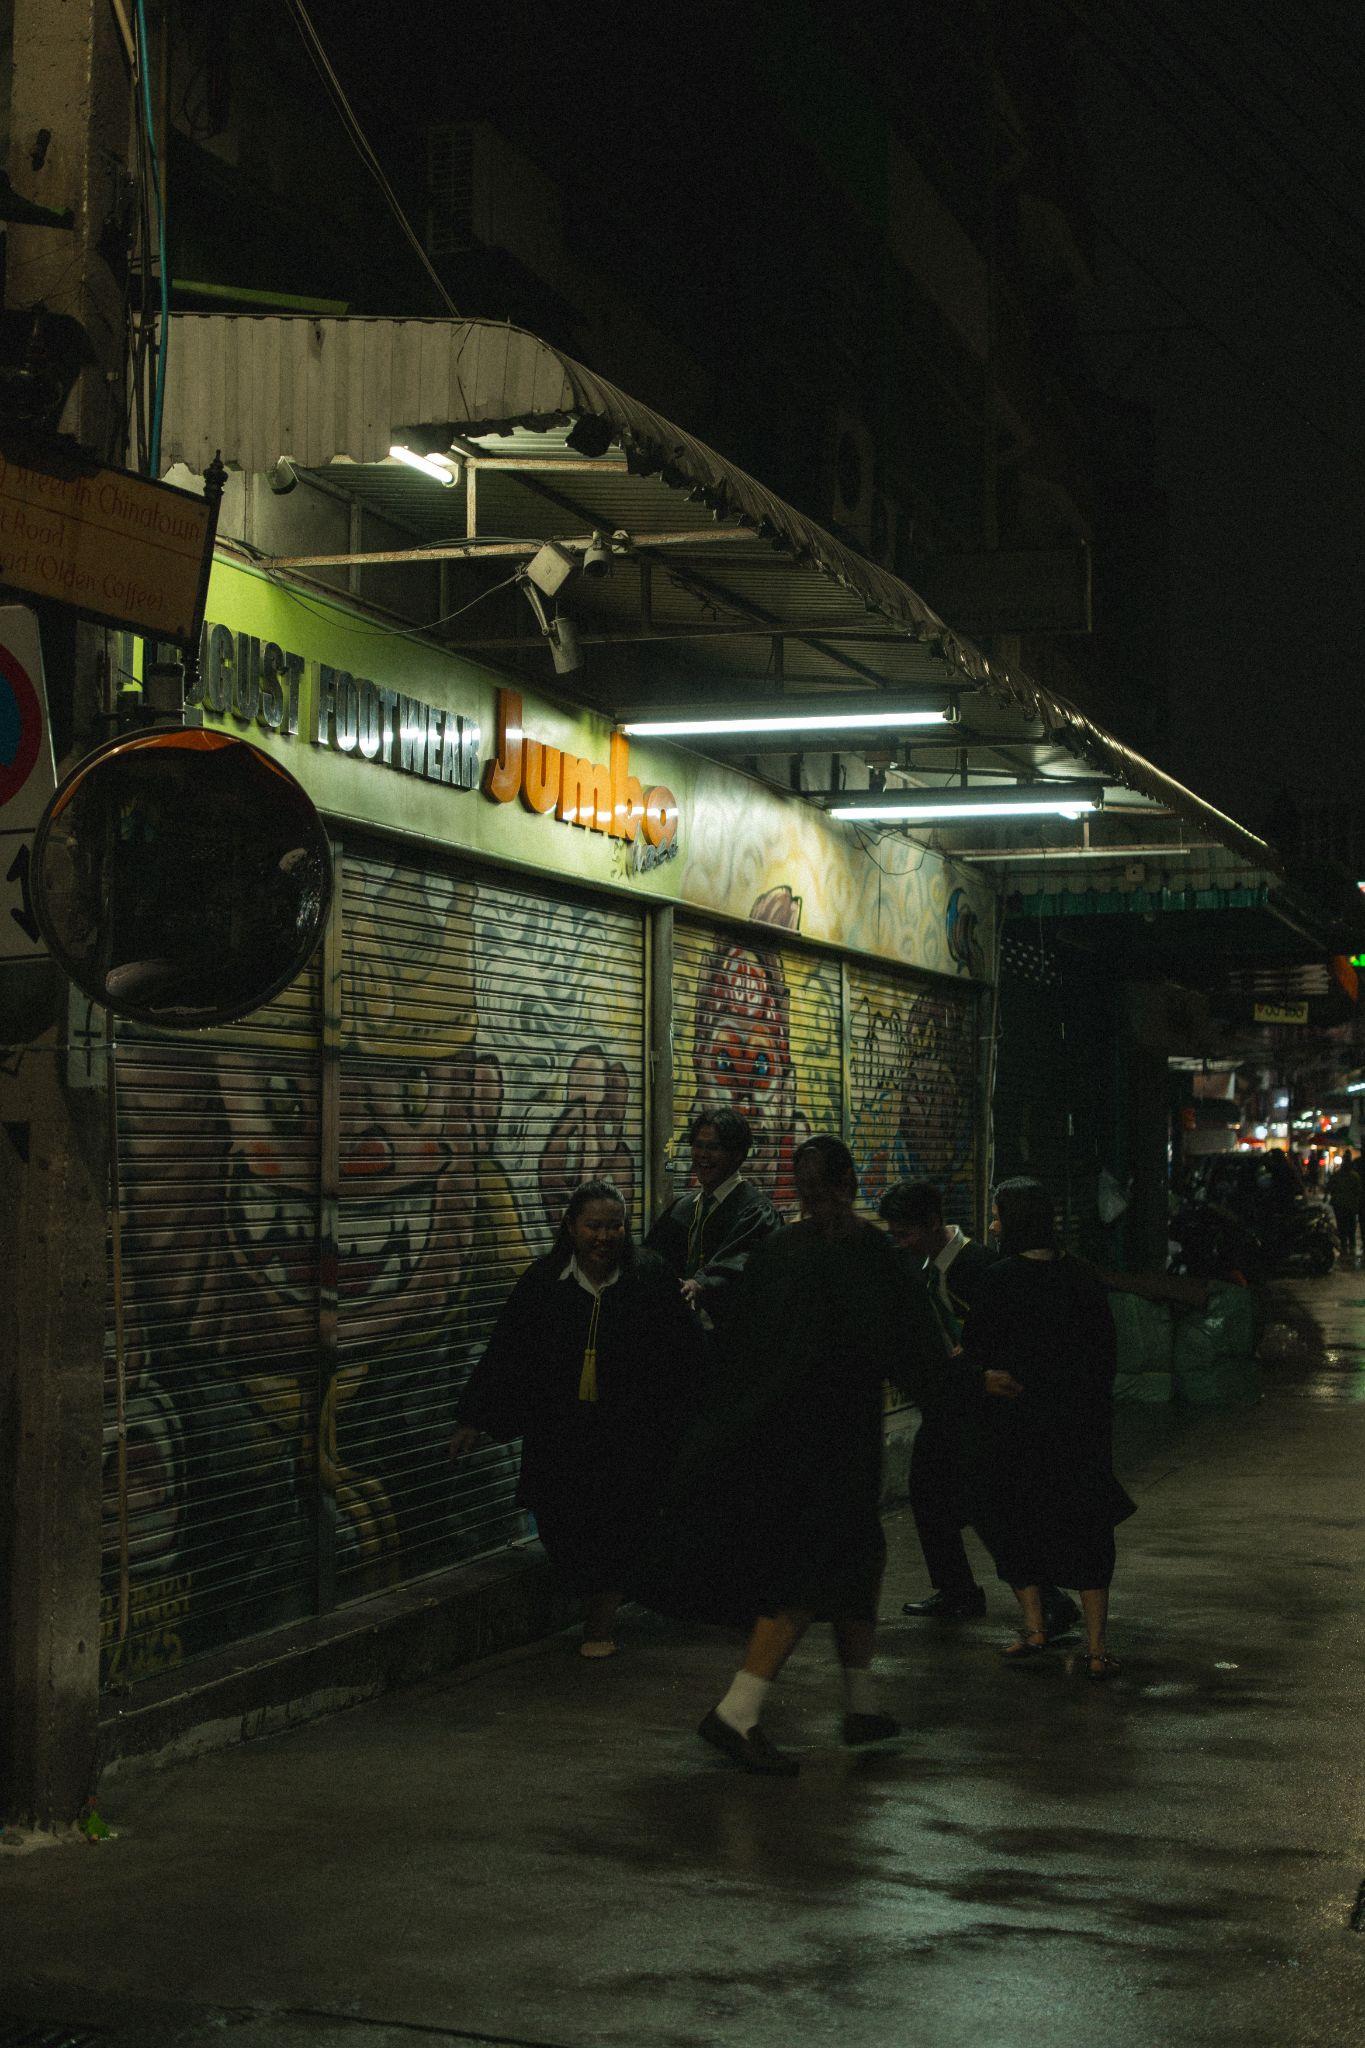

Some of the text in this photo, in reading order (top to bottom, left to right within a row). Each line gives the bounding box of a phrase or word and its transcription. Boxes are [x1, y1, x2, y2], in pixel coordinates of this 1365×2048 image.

[13, 510, 65, 548] Road
[99, 484, 200, 543] Chinatown
[311, 662, 481, 790] FOOTWEAR
[484, 688, 678, 847] Jumbo
